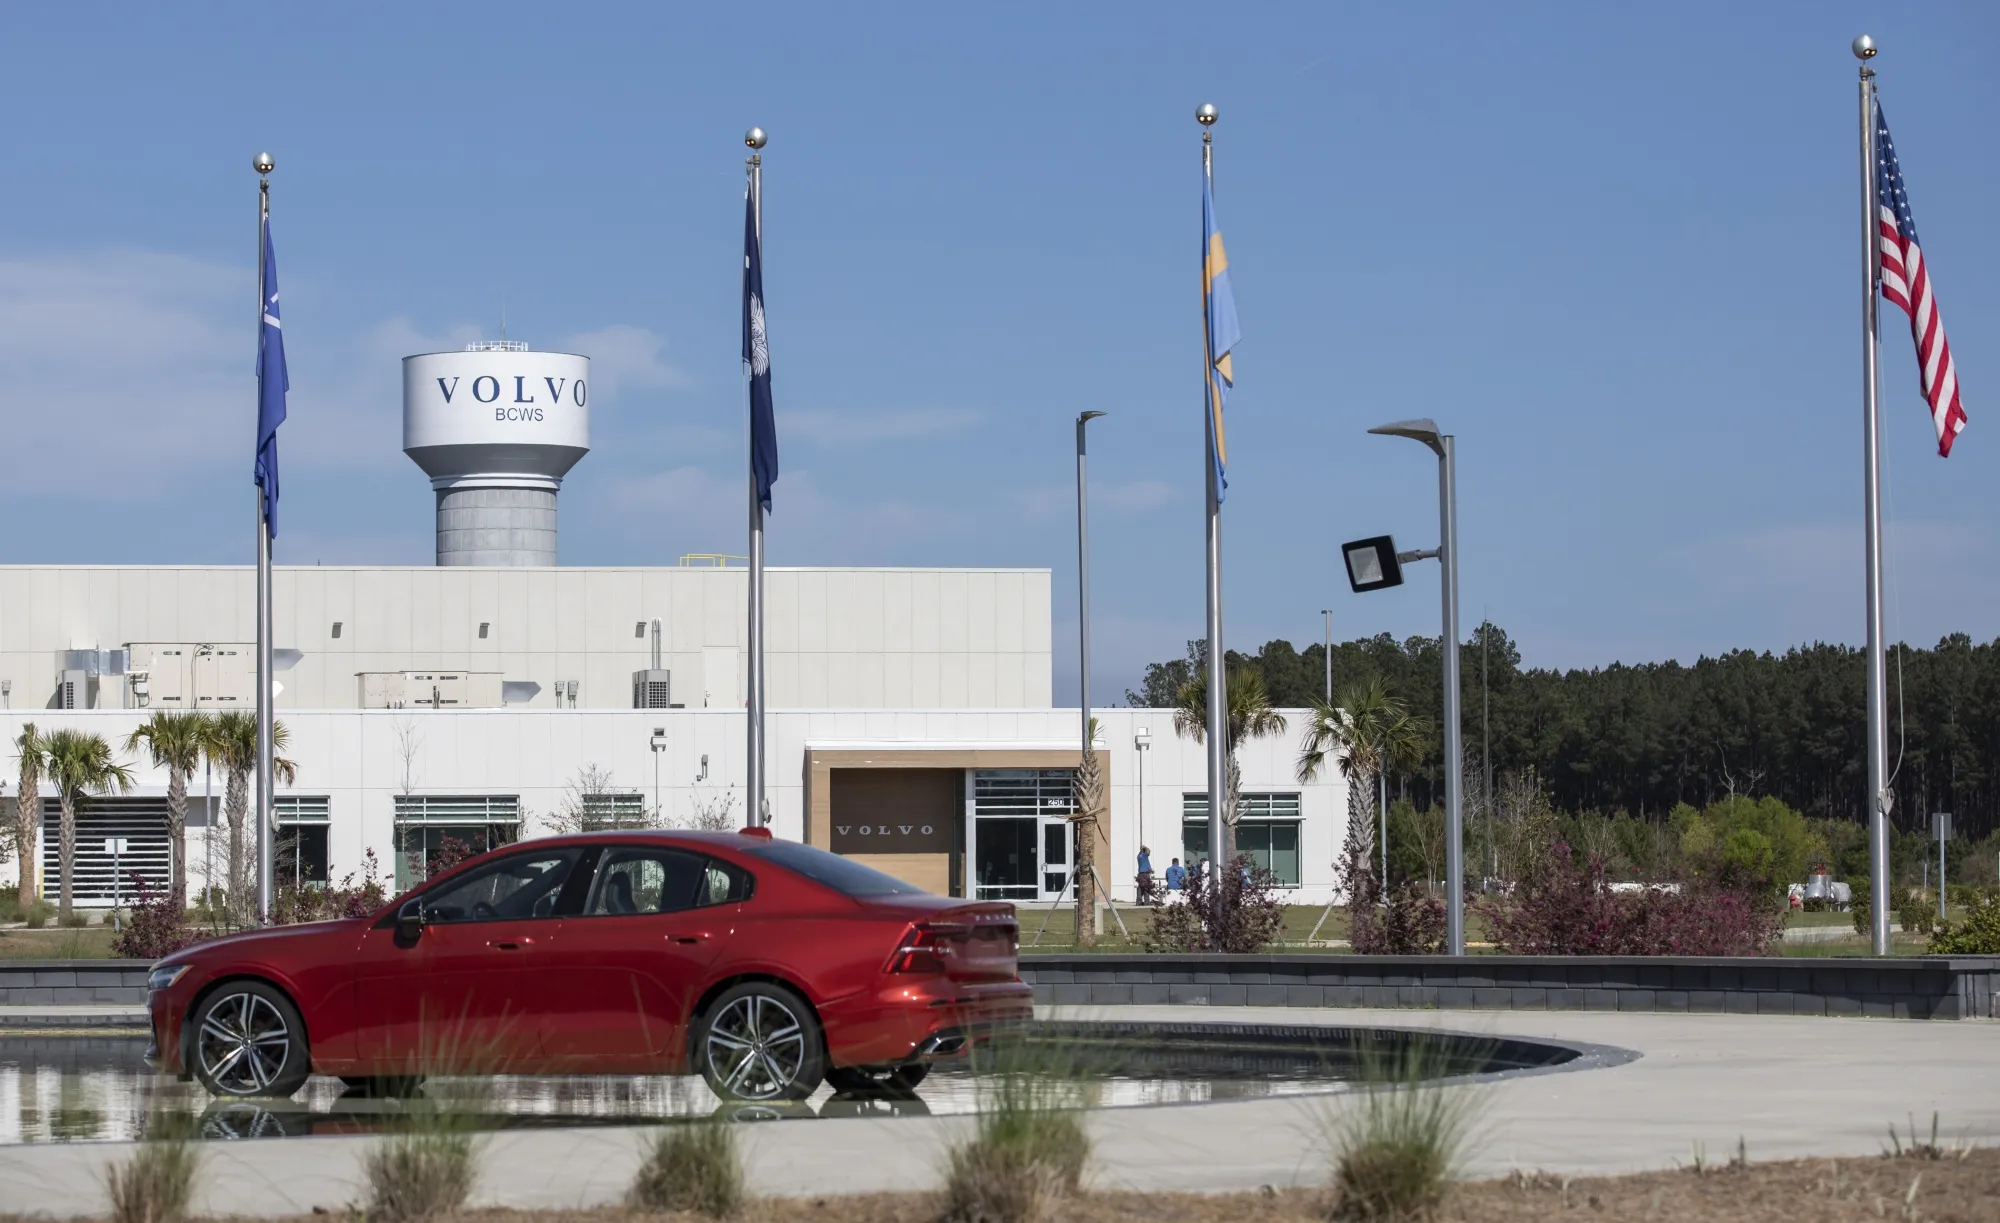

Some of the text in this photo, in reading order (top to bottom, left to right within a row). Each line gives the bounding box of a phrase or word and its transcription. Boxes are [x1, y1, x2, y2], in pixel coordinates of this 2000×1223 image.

[436, 375, 586, 408] VOLVO
[495, 407, 544, 422] BCWS
[1048, 798, 1064, 806] 250
[836, 825, 934, 836] VOLVO
